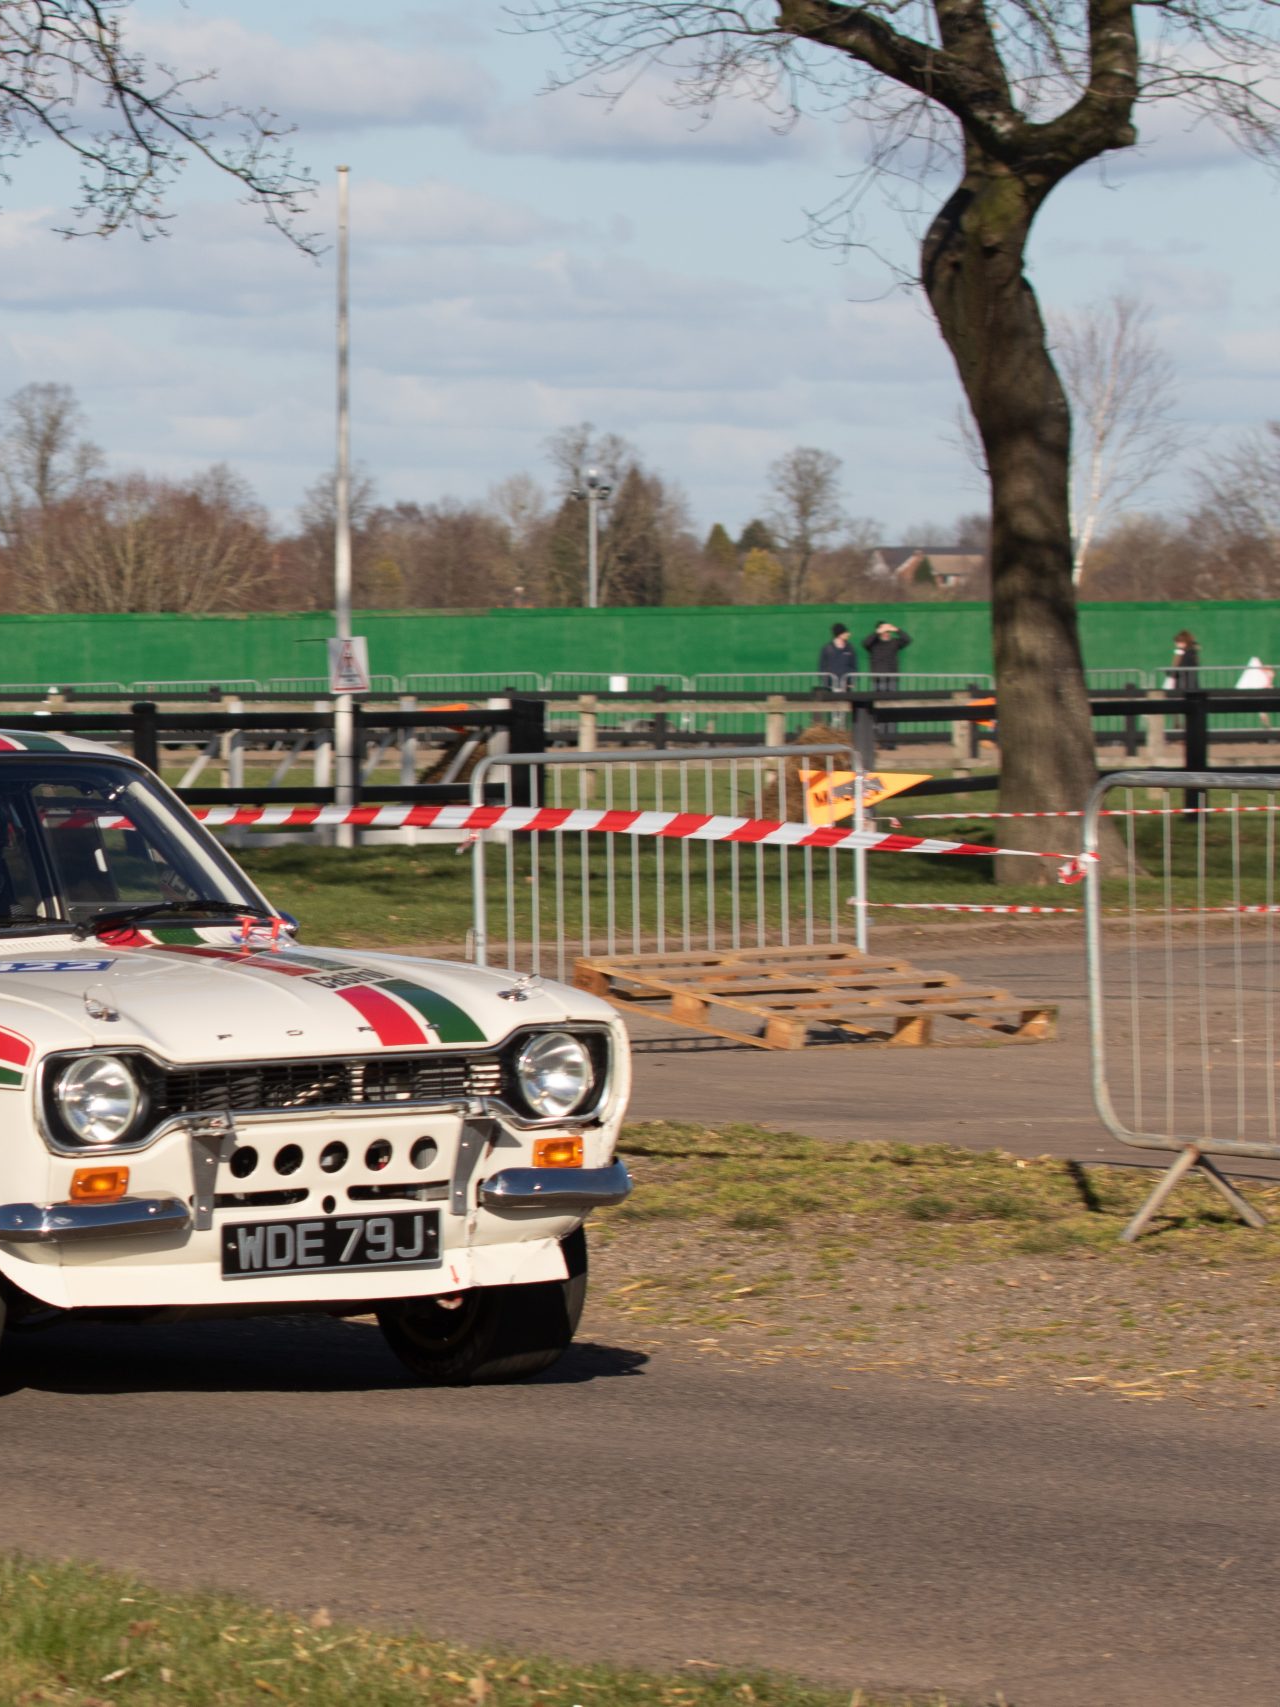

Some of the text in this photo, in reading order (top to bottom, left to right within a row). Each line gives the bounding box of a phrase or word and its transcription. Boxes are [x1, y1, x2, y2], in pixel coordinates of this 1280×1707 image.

[302, 968, 395, 989] Castrol
[237, 1215, 424, 1270] WDE 79J
